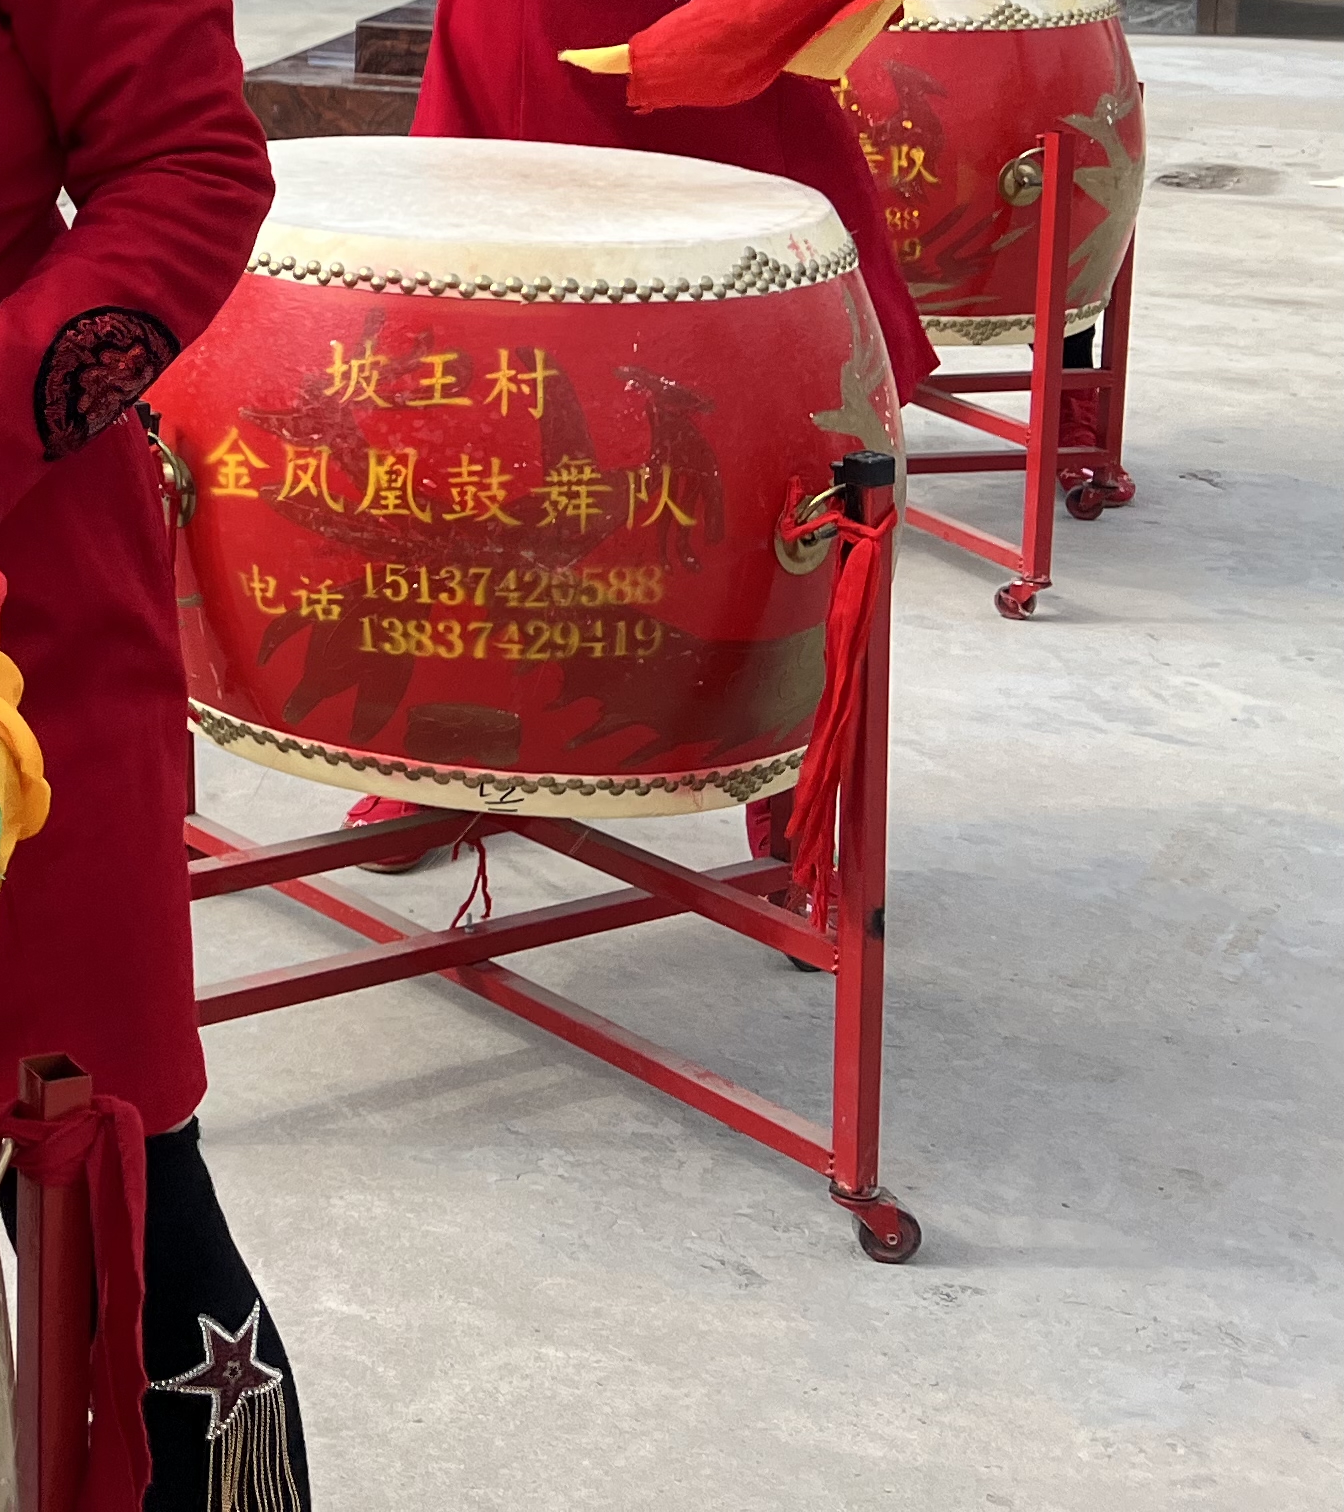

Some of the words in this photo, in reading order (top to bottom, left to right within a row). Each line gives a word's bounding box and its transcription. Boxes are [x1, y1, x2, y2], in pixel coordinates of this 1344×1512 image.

[324, 341, 560, 420] 坡王村
[204, 427, 698, 534] 金凤凰鼓舞队
[239, 562, 346, 623] 电话
[362, 561, 663, 608] 15137420588
[358, 617, 662, 660] 13837429419
